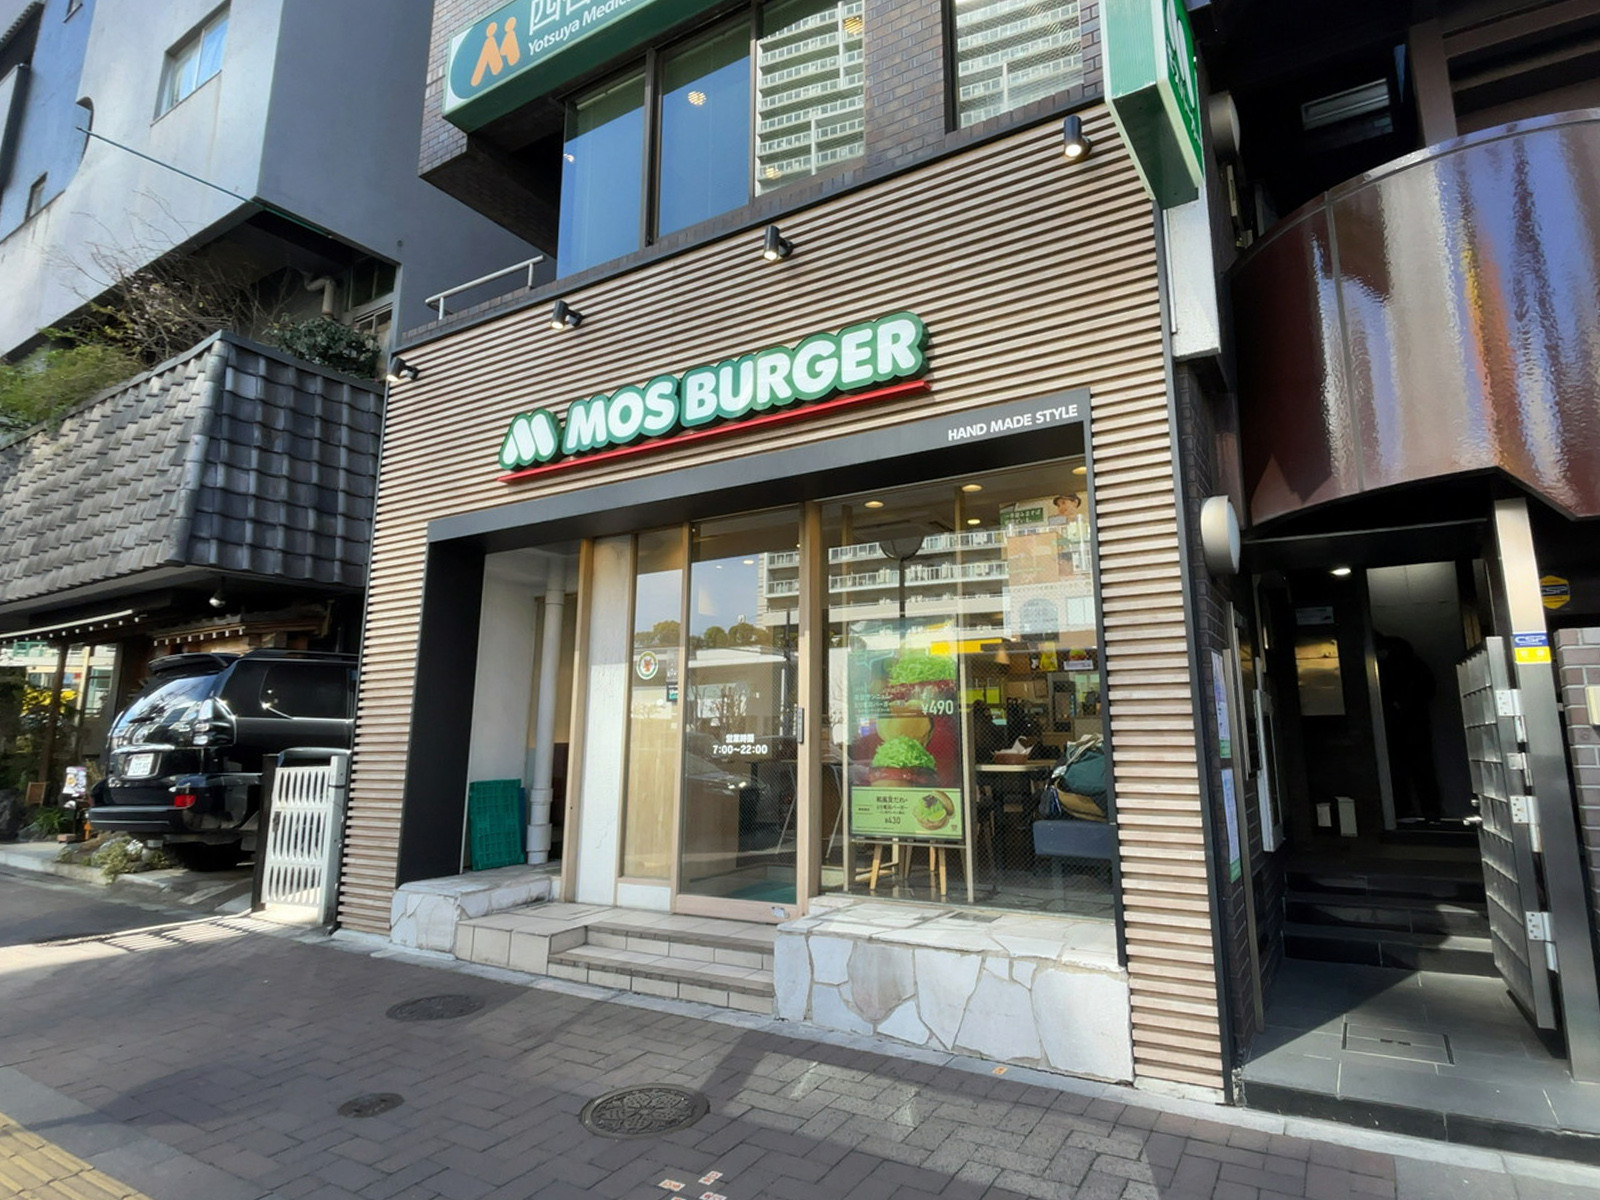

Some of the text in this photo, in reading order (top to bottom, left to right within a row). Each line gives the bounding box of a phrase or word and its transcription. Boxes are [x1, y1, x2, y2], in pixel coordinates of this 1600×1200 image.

[528, 0, 631, 55] Yotsuya Medic
[567, 380, 674, 451] MOS
[685, 318, 922, 420] BURGER
[948, 404, 1078, 441] HAND MADE STYLE
[921, 699, 954, 716] ¥490
